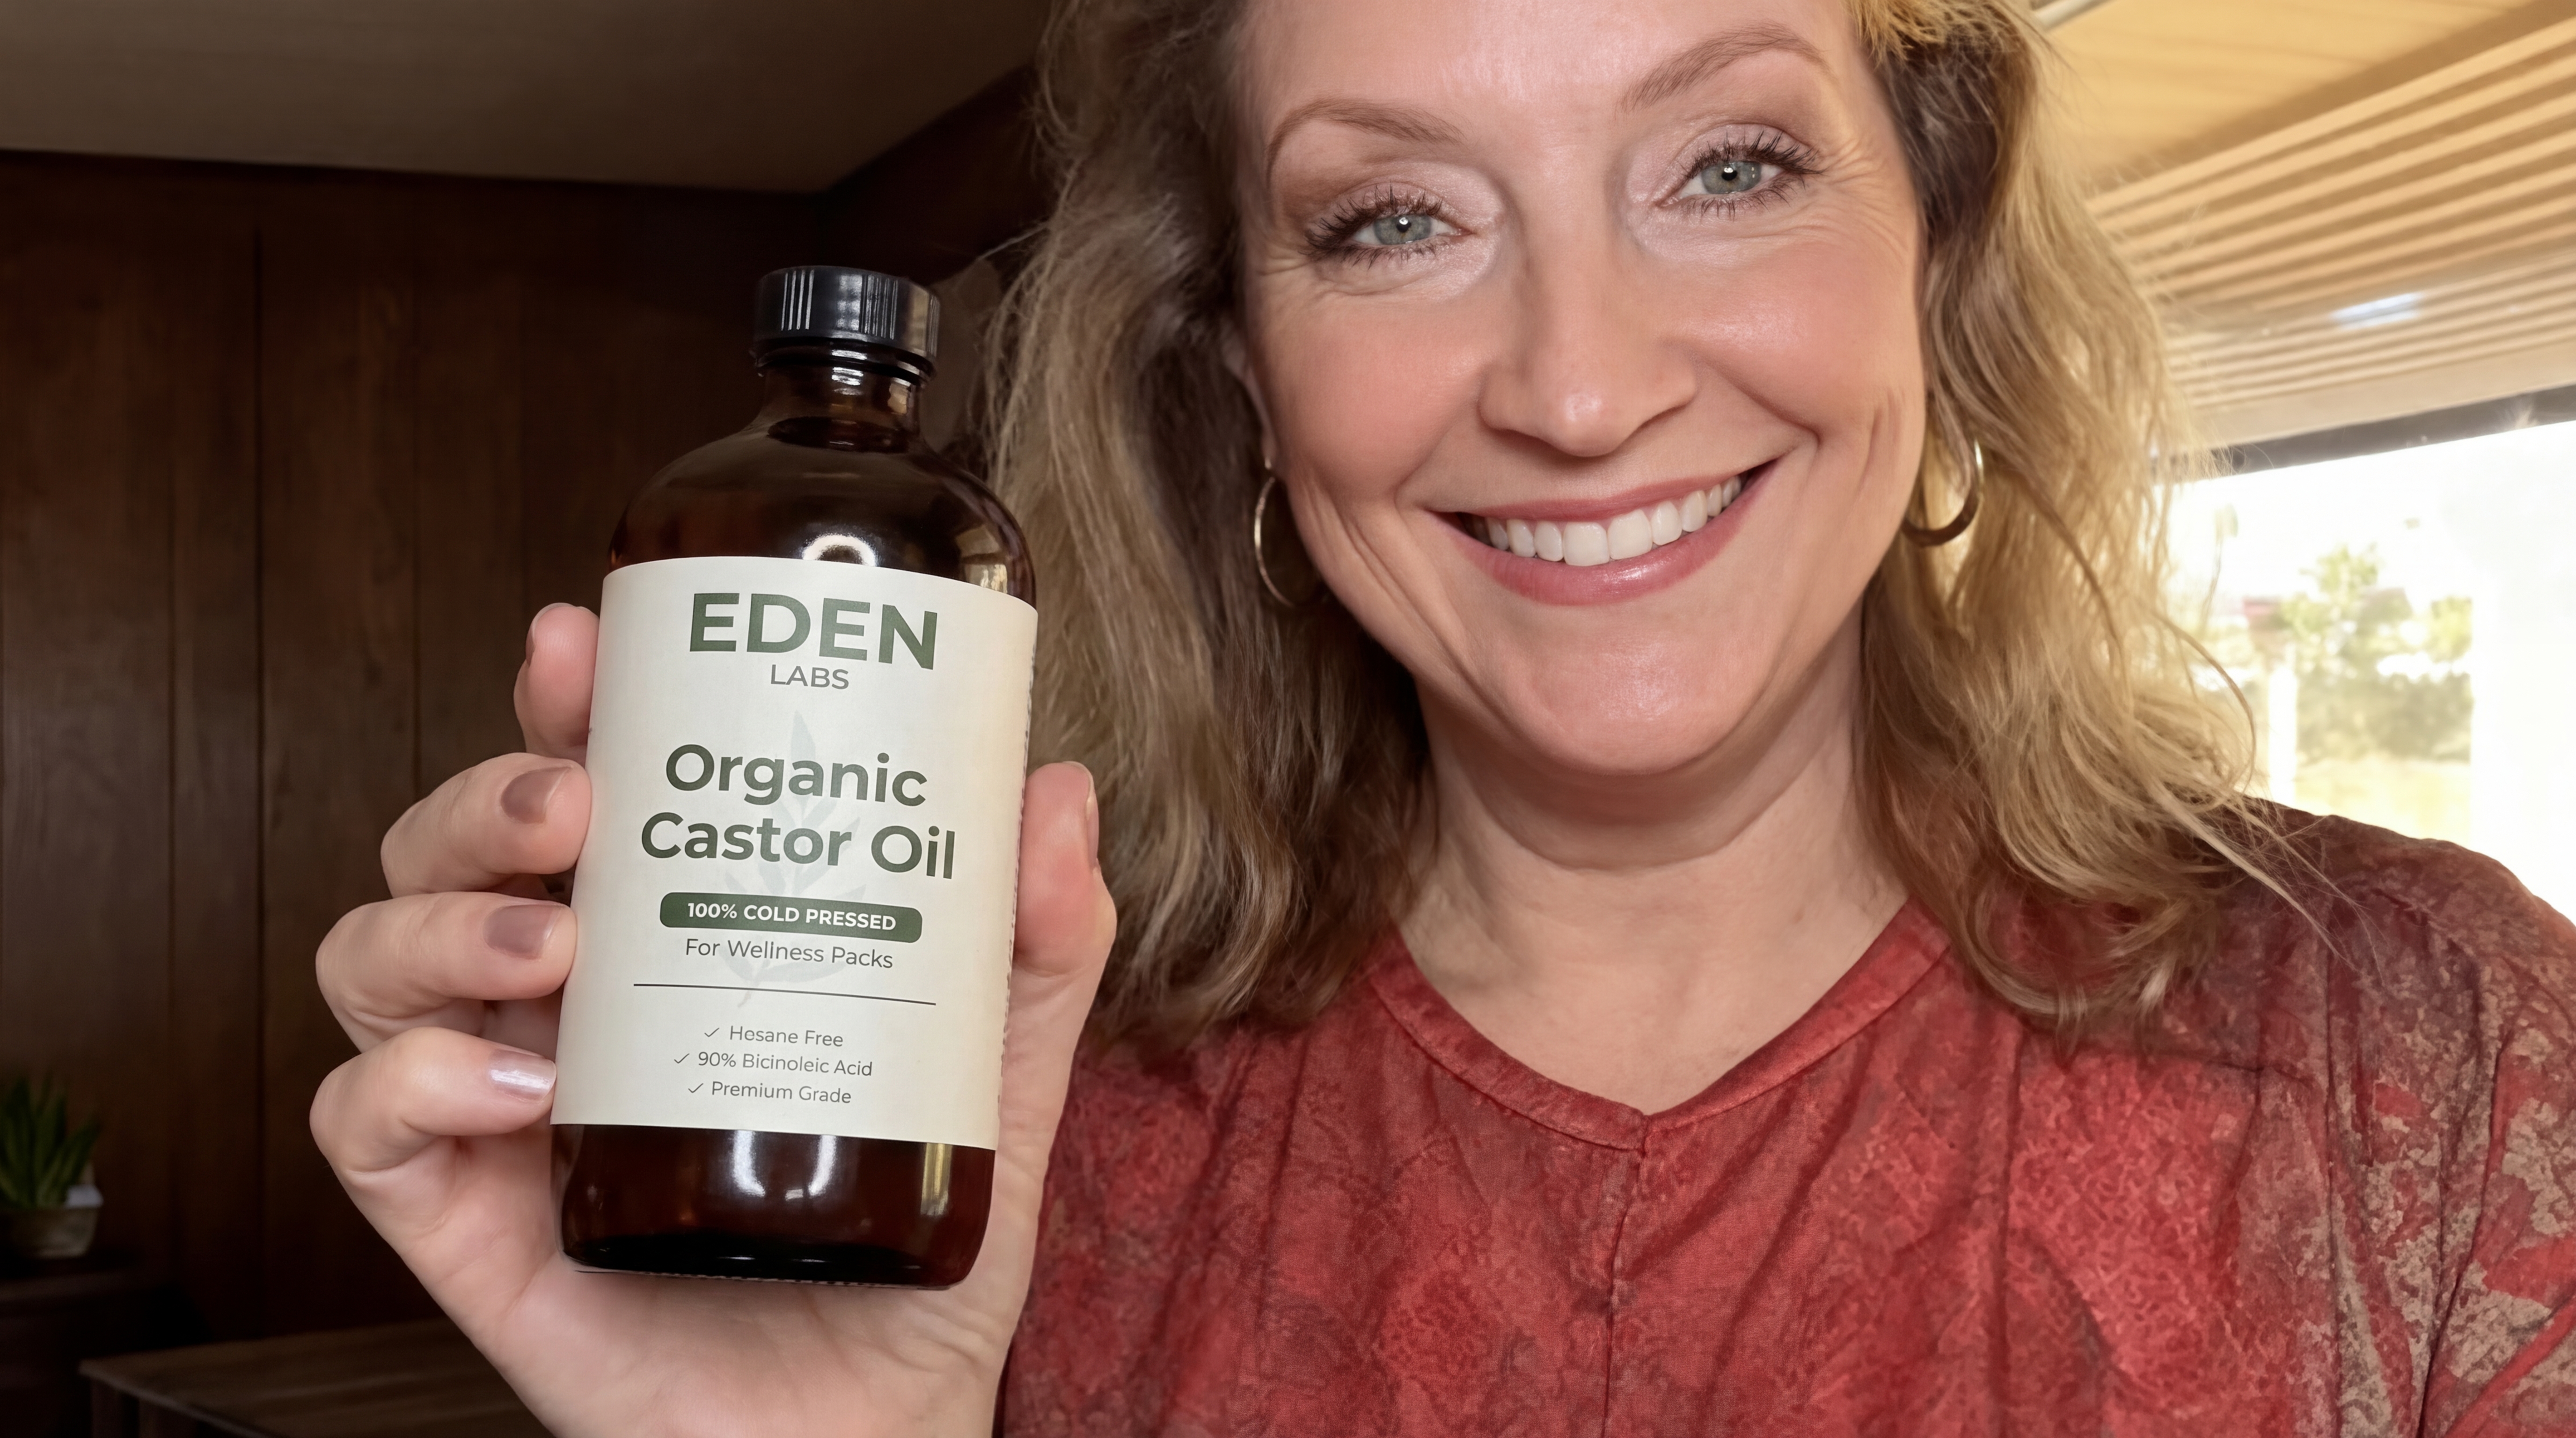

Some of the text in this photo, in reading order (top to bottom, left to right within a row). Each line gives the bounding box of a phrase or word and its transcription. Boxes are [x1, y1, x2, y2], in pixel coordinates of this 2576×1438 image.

[689, 592, 938, 670] EDEN
[770, 664, 849, 690] LABS
[665, 743, 928, 807] Organic
[641, 811, 852, 866] Castor
[871, 825, 955, 880] Oil
[687, 902, 897, 931] 100% COLD PRESSED
[685, 938, 721, 956] For
[831, 946, 893, 968] Packs
[729, 1025, 844, 1048] Hesane Free
[698, 1051, 873, 1077] 90% Bicinoleic Acid
[711, 1080, 852, 1104] Premium Grade
